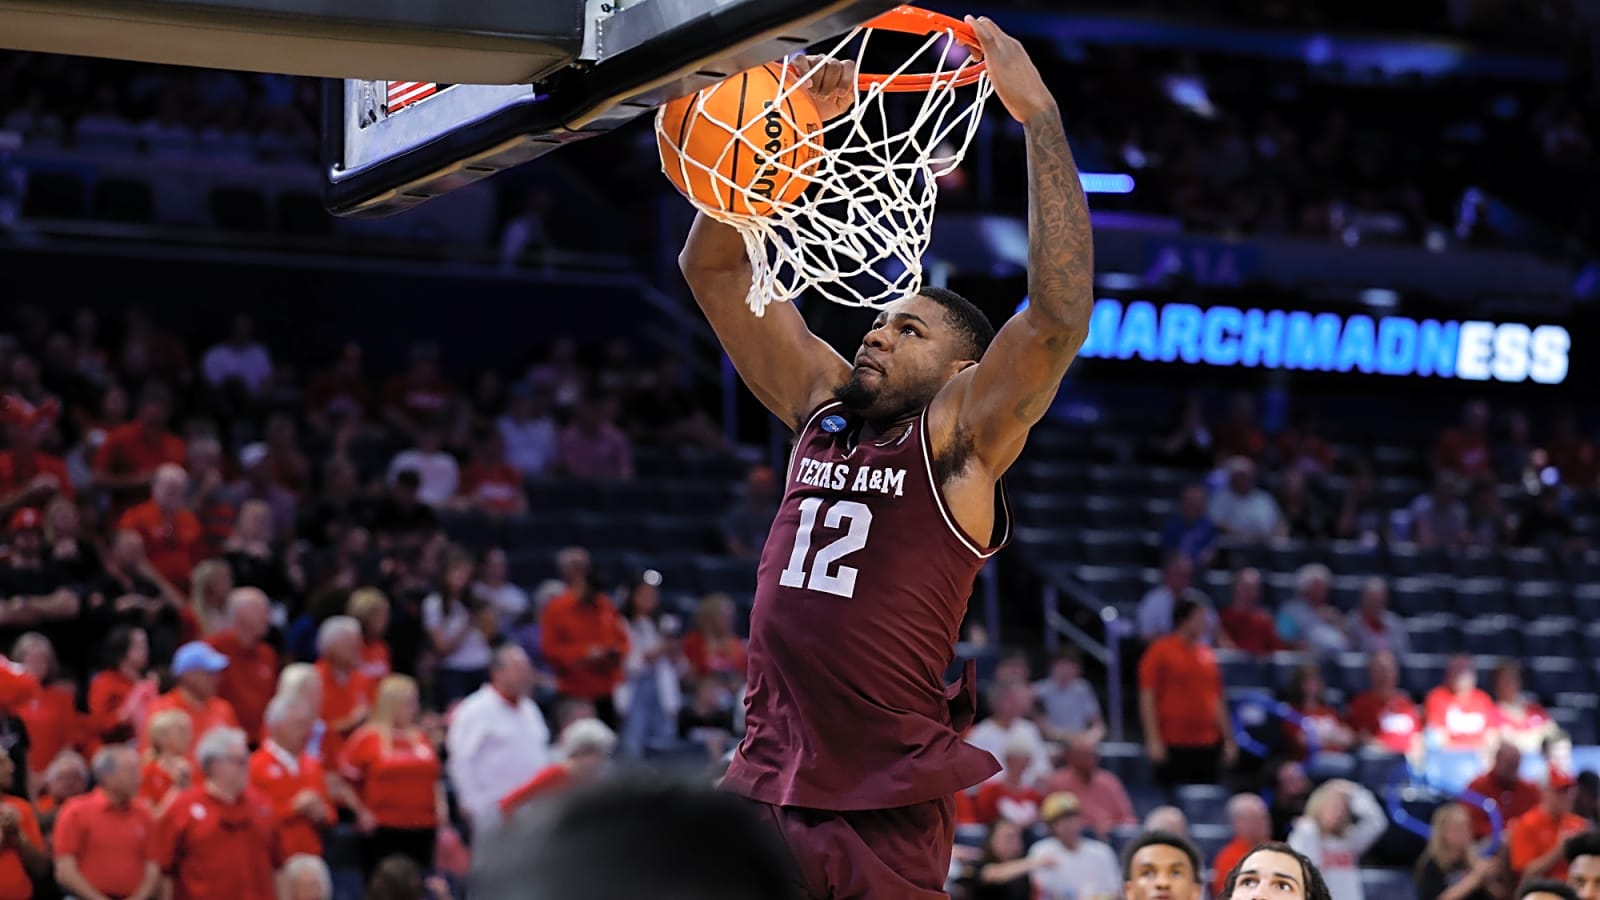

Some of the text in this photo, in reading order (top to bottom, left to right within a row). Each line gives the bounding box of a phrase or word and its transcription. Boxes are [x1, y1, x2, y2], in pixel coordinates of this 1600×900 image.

[1016, 296, 1571, 385] MARCHMADNESS
[796, 457, 907, 496] TEXAS A&M
[779, 497, 873, 599] 12
